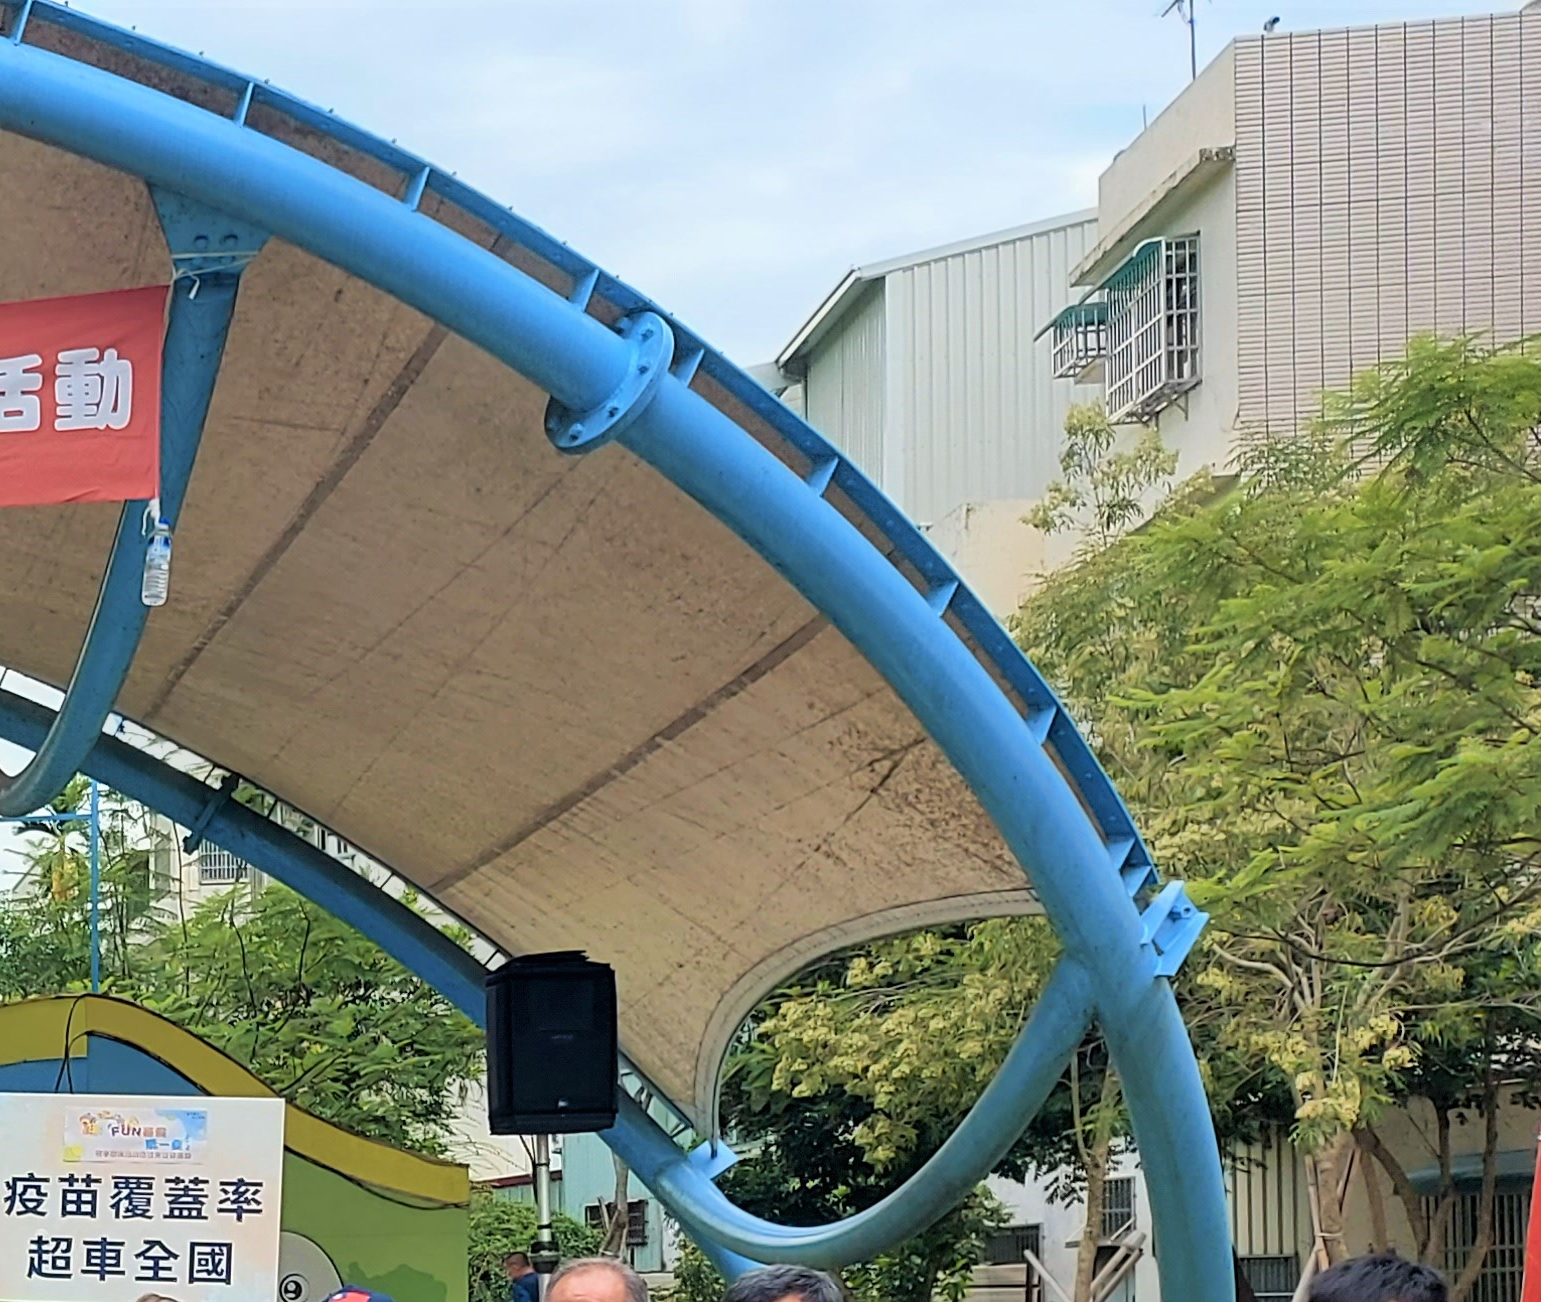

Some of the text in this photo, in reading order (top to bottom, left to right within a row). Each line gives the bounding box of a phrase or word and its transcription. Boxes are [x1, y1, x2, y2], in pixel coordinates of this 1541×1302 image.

[2, 1171, 265, 1224] 疫苗覆蓋率
[26, 1233, 234, 1287] 超車全國
